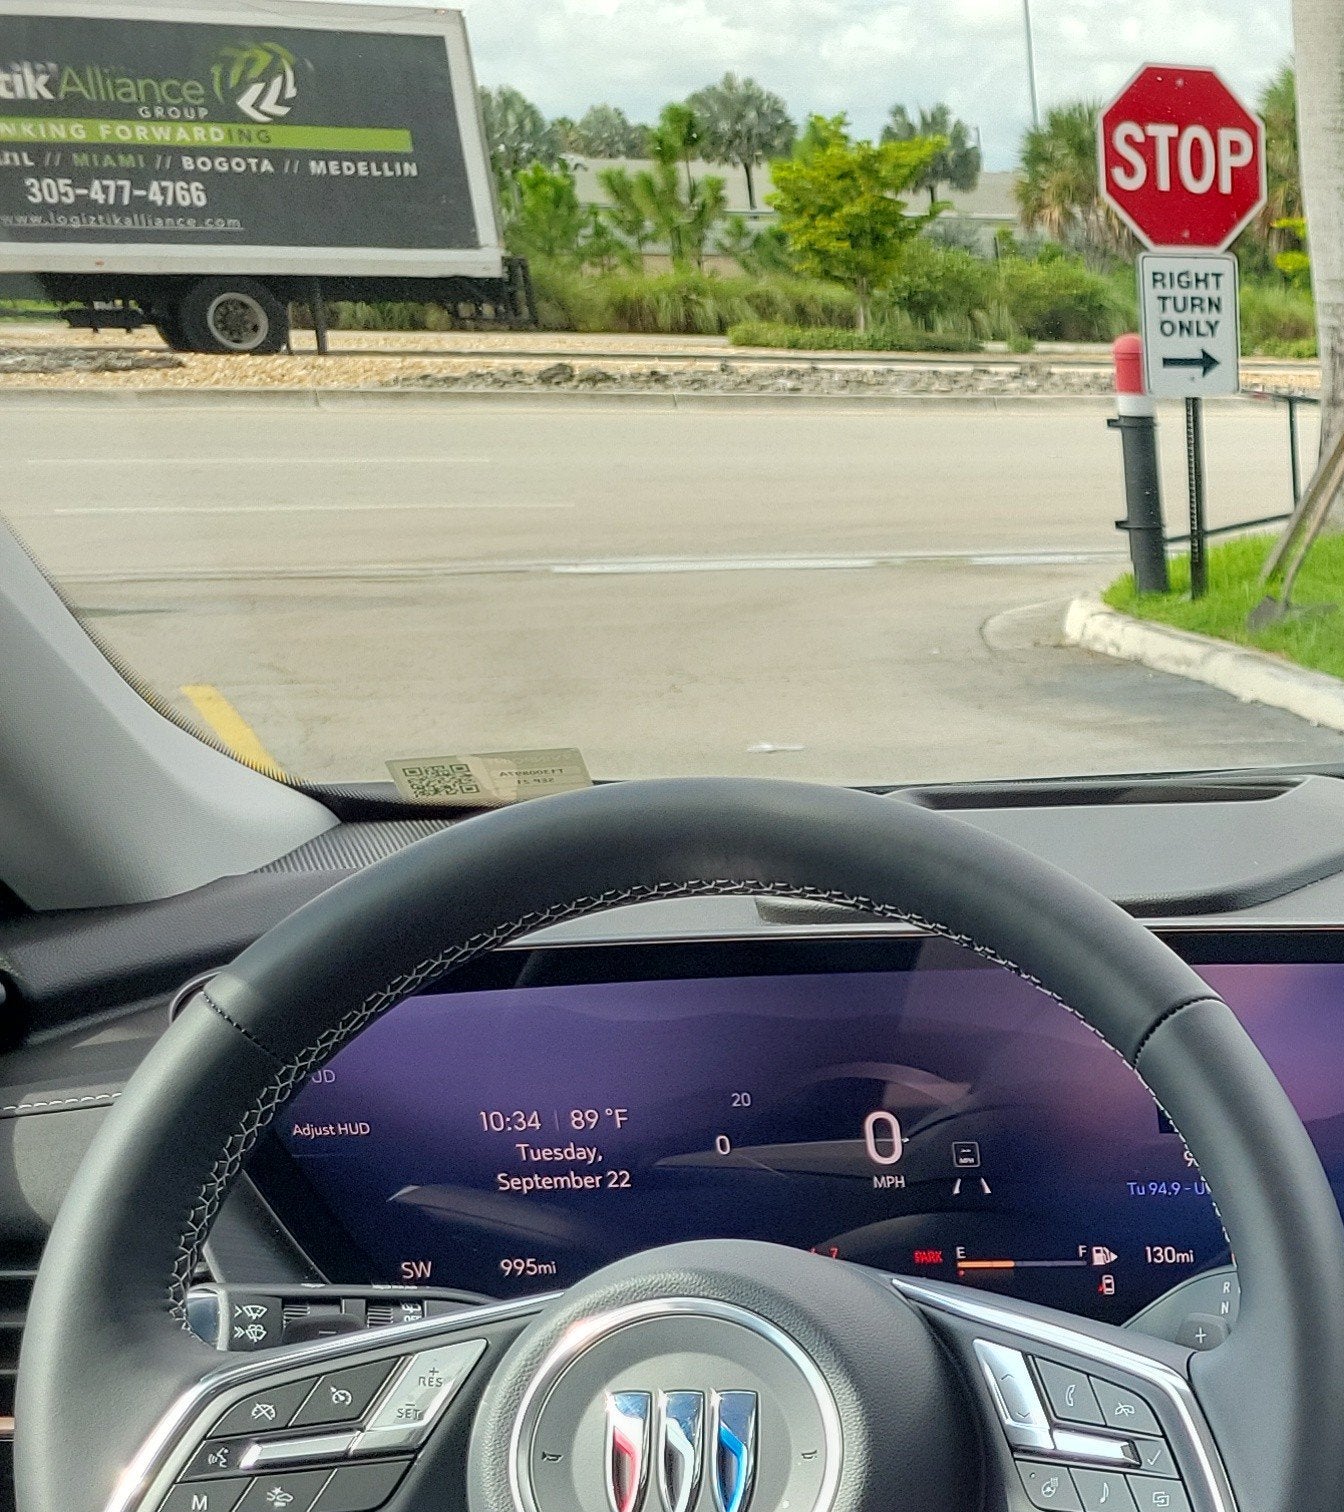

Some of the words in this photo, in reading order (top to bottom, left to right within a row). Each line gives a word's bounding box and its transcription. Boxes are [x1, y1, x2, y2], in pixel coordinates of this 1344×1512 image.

[137, 106, 209, 119] GROUP
[73, 152, 146, 168] MIAMI
[181, 155, 275, 174] BOGOTA
[309, 160, 418, 177] MEDELLIN
[1111, 120, 1254, 195] STOP
[24, 177, 208, 207] 305-477-4766
[1151, 271, 1225, 290] RIGHT
[1157, 296, 1223, 314] TURN
[1159, 319, 1222, 338] ONLY
[731, 1092, 751, 1108] 20
[479, 1110, 541, 1132] 10:34
[570, 1109, 599, 1130] 89
[292, 1123, 336, 1139] Adjust
[337, 1122, 370, 1136] HUD
[863, 1110, 903, 1166] 0
[515, 1143, 604, 1163] Tuesday,
[715, 1135, 731, 1155] 0
[497, 1172, 602, 1193] September
[606, 1171, 632, 1188] 22
[873, 1175, 905, 1188] MPH
[1126, 1181, 1146, 1196] Tu
[1148, 1182, 1181, 1196] 94.9
[956, 1246, 966, 1259] E
[1079, 1245, 1087, 1257] F
[1145, 1246, 1195, 1264] 130mi
[401, 1261, 432, 1279] SW
[500, 1258, 557, 1276] 995mi
[1223, 1282, 1231, 1294] R
[1221, 1302, 1229, 1314] N
[418, 1376, 444, 1388] RES
[396, 1407, 422, 1420] SET
[191, 1495, 208, 1511] M
